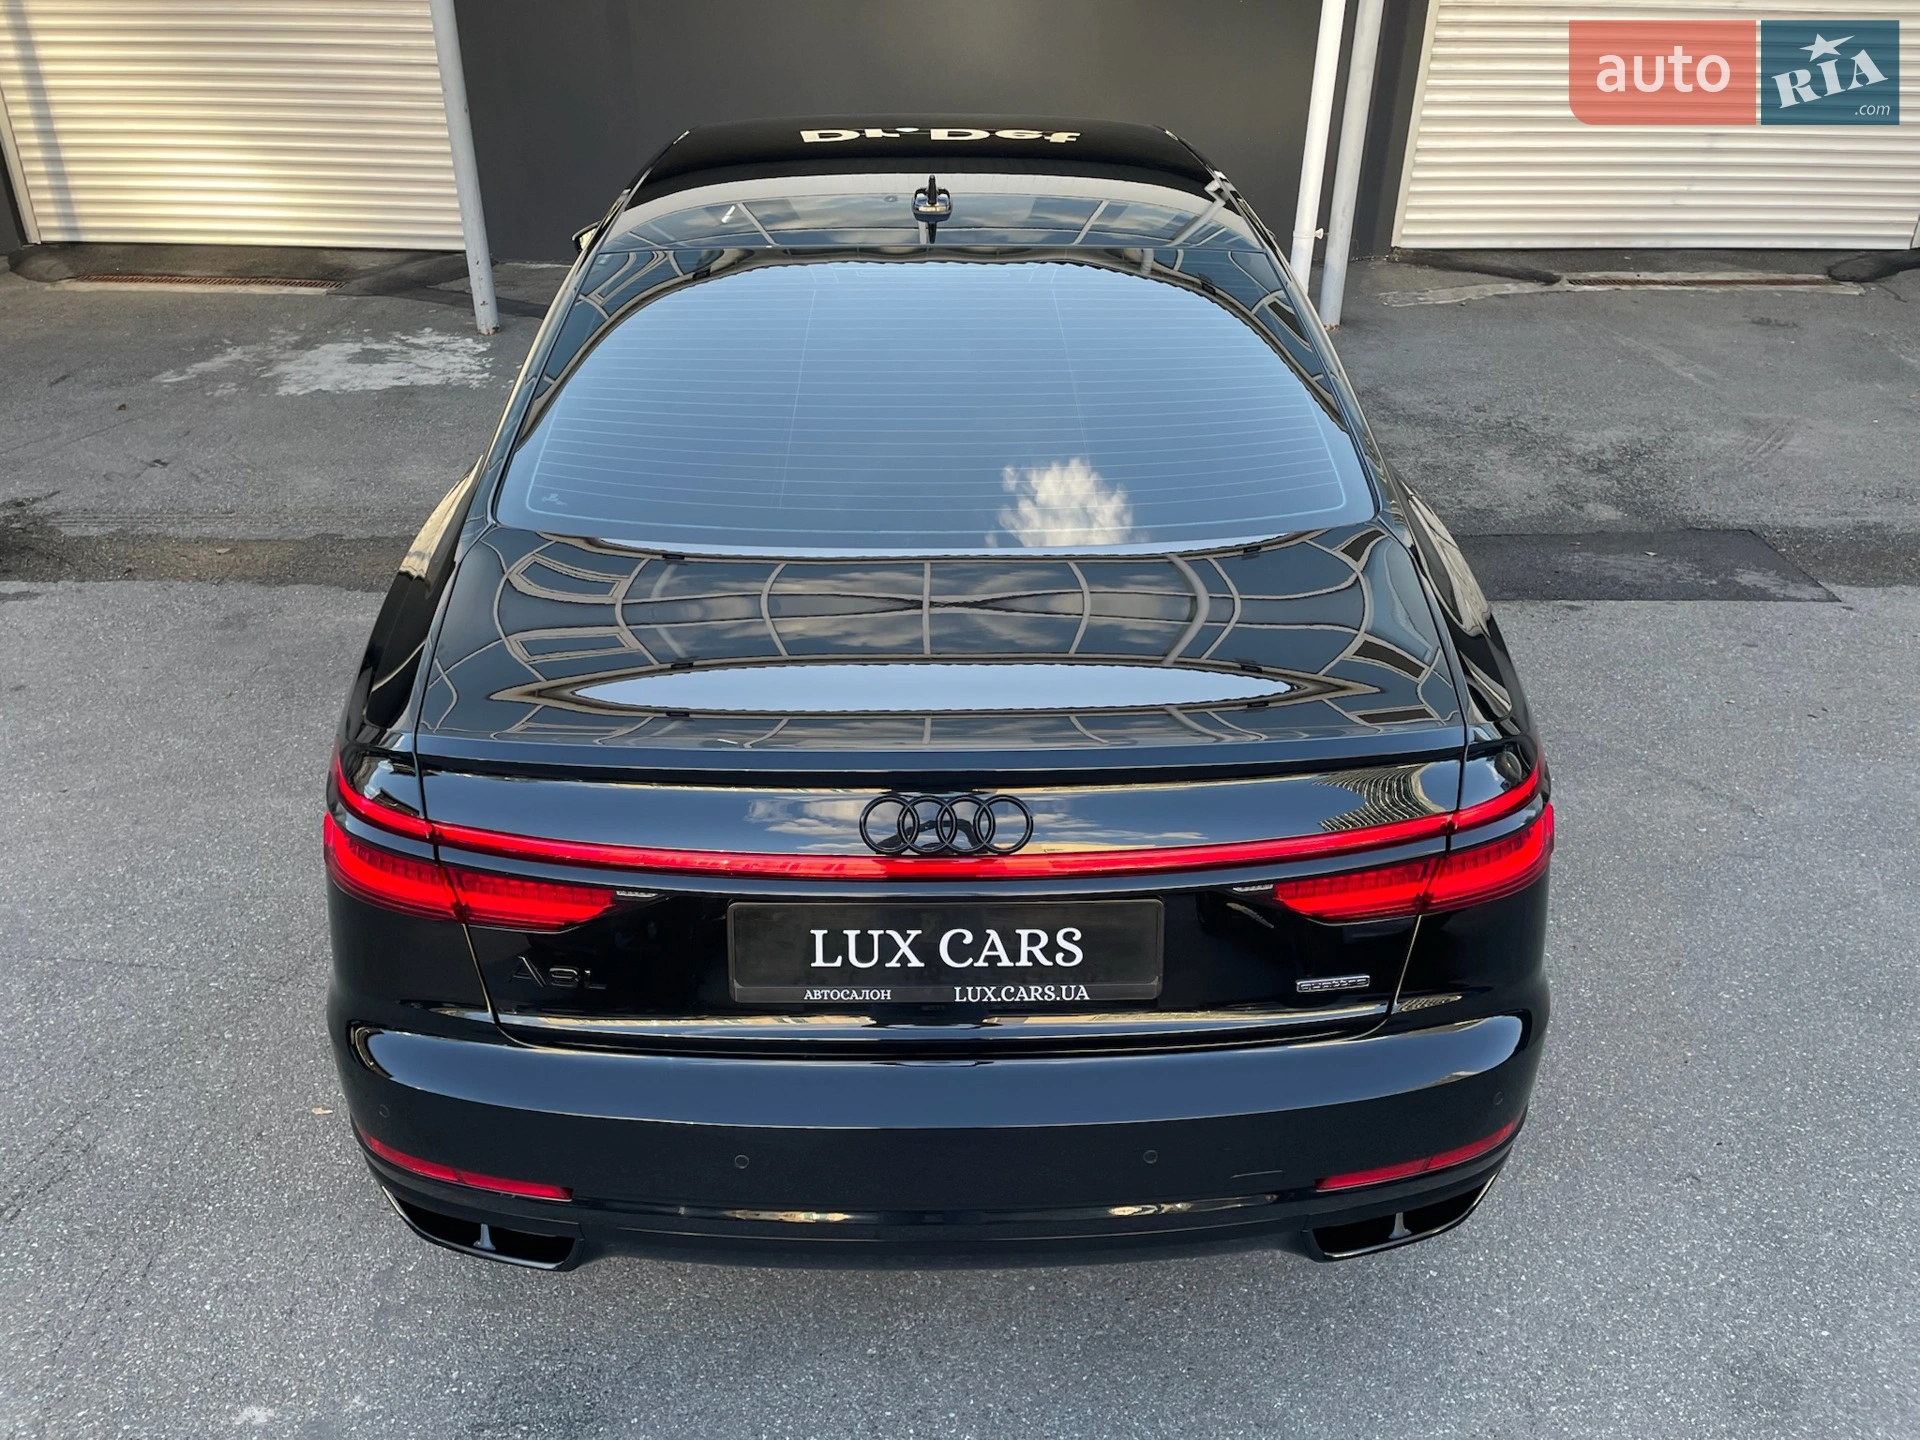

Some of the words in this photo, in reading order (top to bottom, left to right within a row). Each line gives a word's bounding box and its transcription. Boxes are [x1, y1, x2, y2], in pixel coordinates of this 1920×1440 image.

[810, 929, 925, 968] LUX
[938, 927, 1084, 968] CARS
[803, 988, 892, 1001] АВТОСАЛОН
[954, 984, 1090, 1002] LUX.CARS.UA
